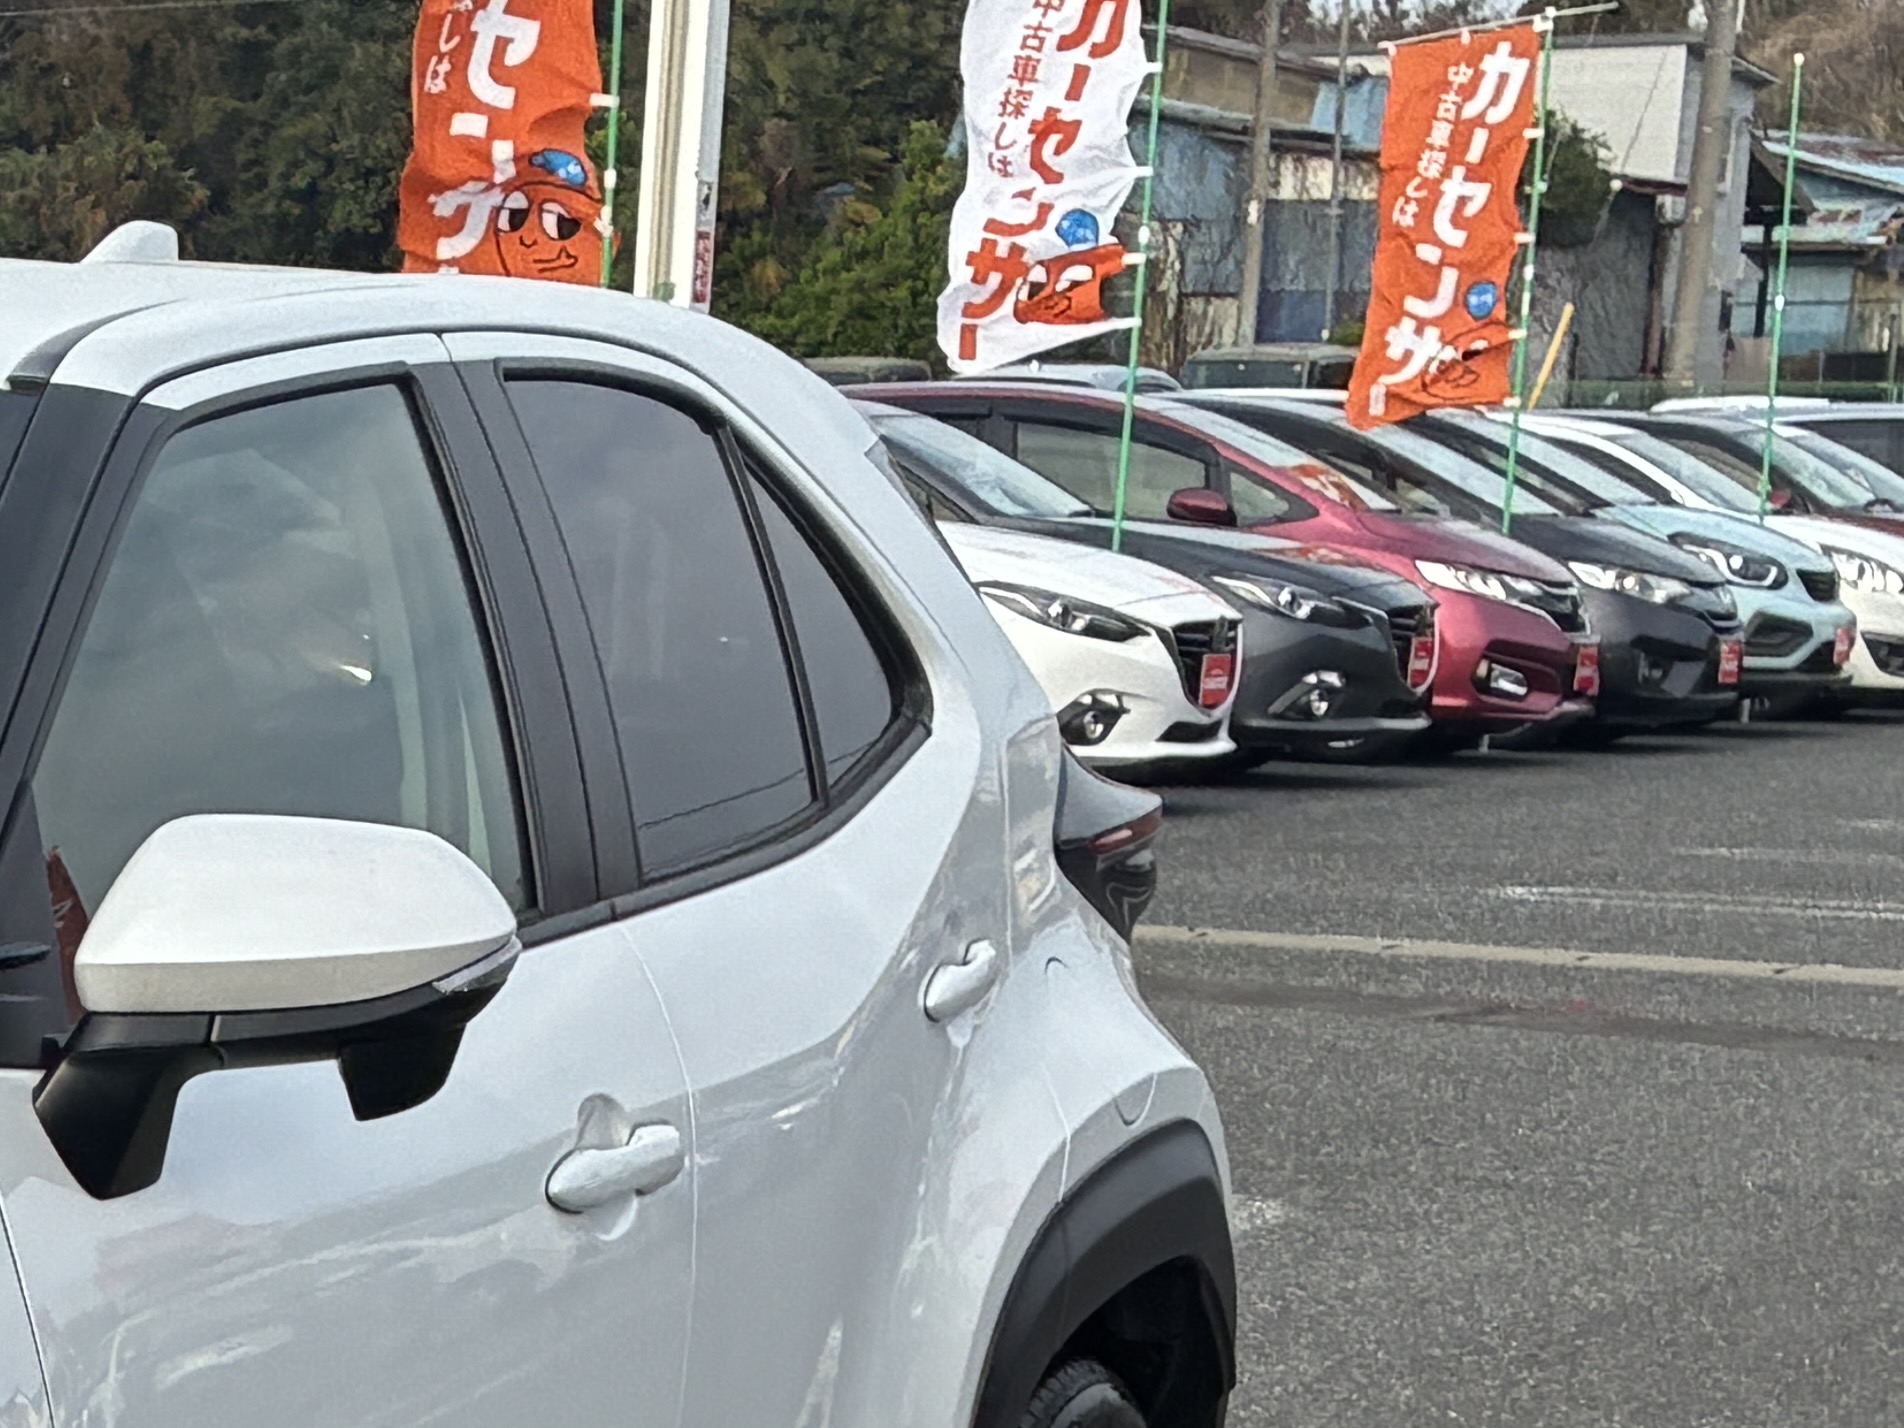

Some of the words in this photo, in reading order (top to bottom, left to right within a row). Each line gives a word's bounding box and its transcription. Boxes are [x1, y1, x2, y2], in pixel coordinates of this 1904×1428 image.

[1369, 40, 1531, 417] カーセンサー
